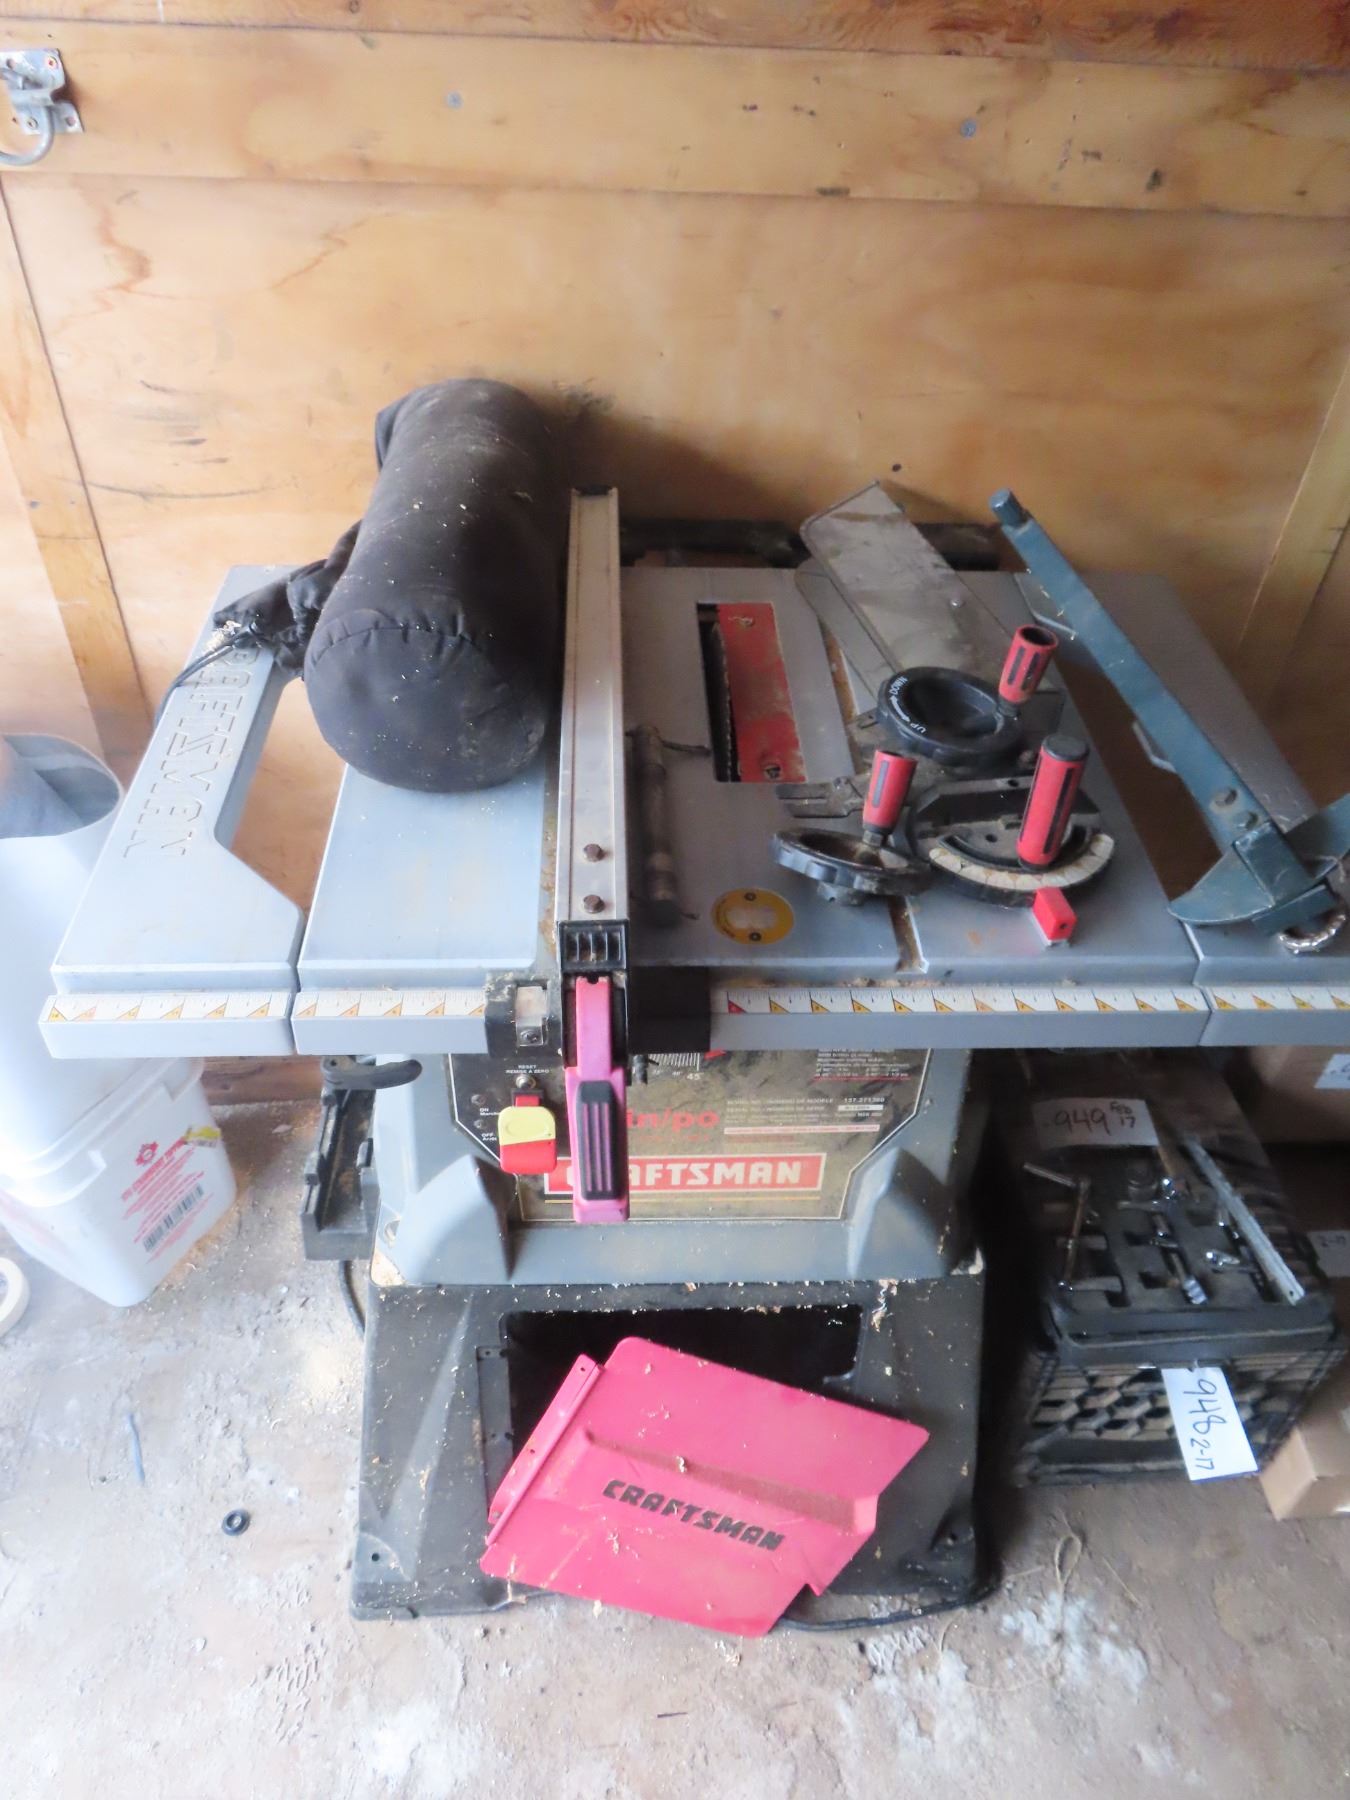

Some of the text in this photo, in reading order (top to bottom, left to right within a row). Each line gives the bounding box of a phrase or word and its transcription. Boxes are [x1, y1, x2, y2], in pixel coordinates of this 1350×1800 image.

[888, 676, 908, 695] DOWN
[910, 723, 927, 734] UP
[1055, 1107, 1111, 1136] 949
[1120, 1116, 1136, 1129] 17
[567, 1161, 801, 1187] AFTSMAN
[1183, 1378, 1227, 1435] 948
[1190, 1437, 1215, 1471] 2-17
[603, 1480, 785, 1551] CRAFTSMAN
